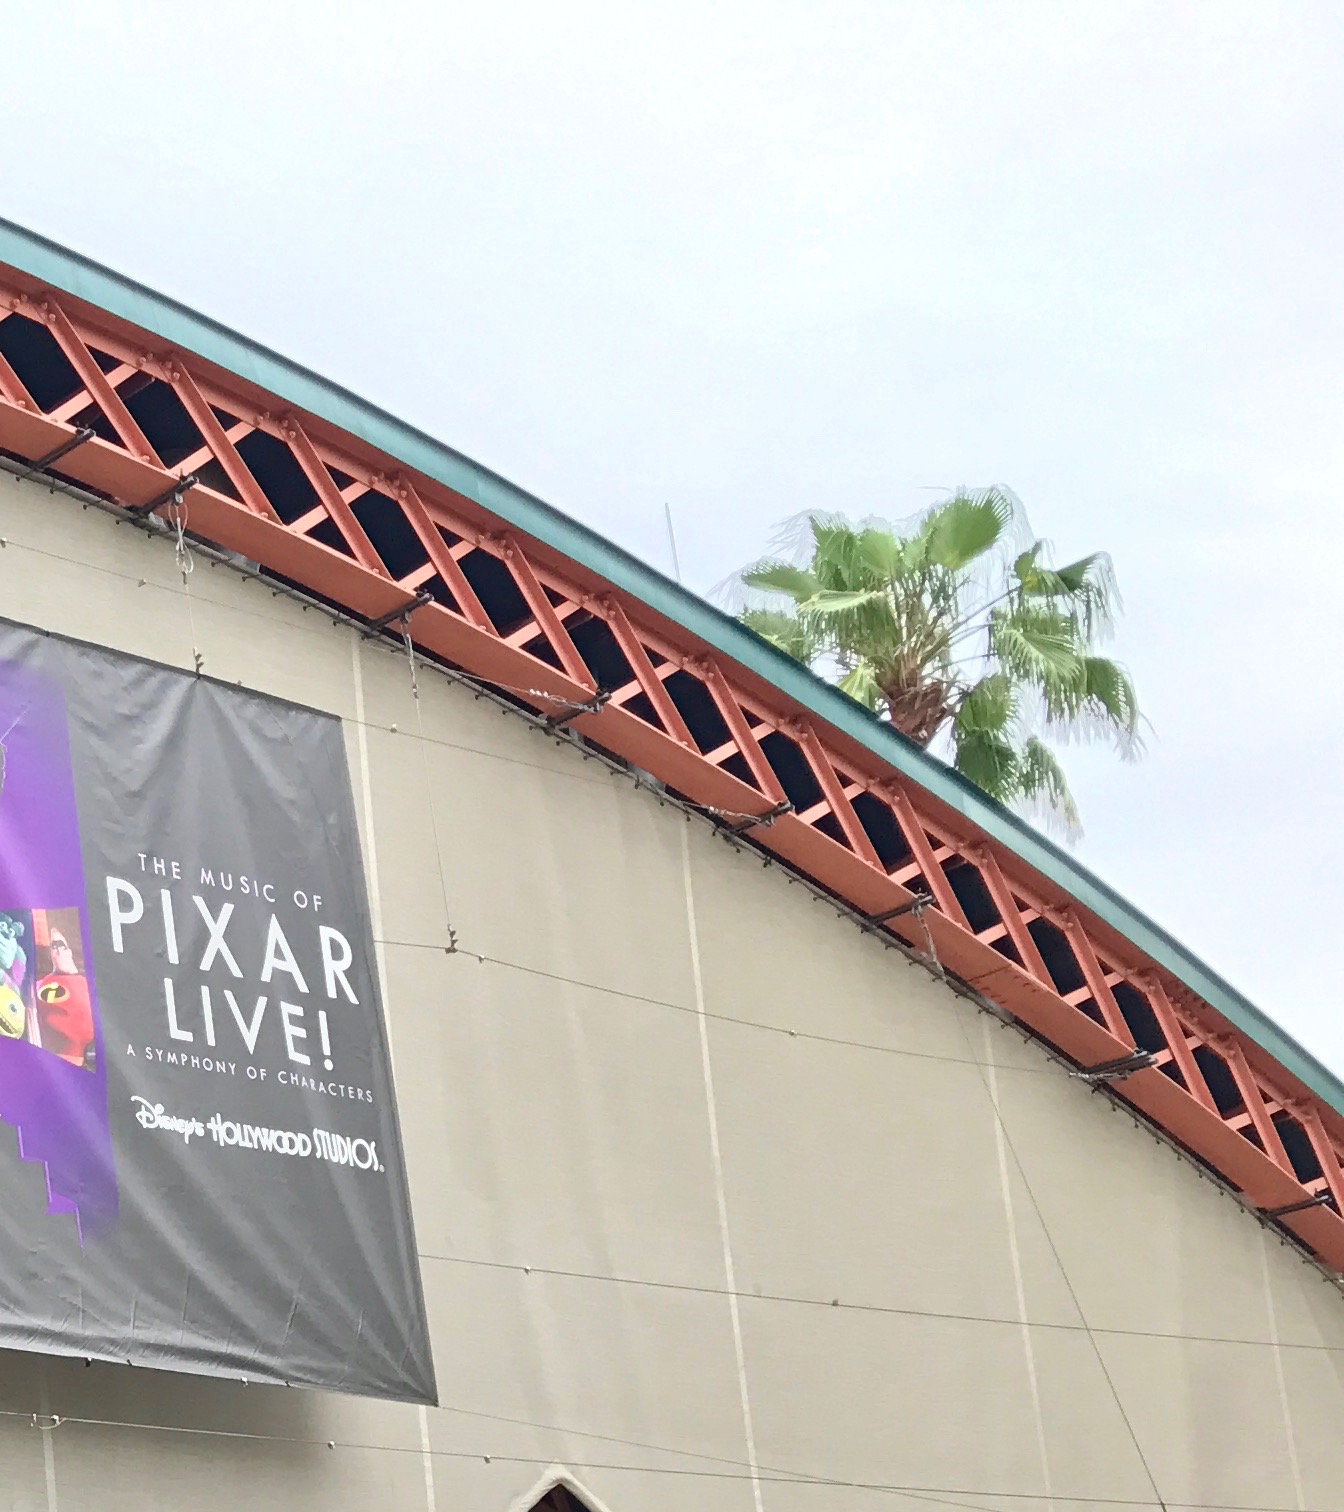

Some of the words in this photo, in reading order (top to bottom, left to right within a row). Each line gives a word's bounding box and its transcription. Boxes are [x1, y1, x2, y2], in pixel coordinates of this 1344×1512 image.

[138, 853, 181, 880] THE
[200, 868, 275, 903] MUSIC
[293, 891, 322, 912] OF
[105, 875, 359, 1005] PIXAR
[164, 978, 334, 1071] LIVE!
[126, 1044, 136, 1057] A
[145, 1047, 236, 1075] SYMPHONY
[246, 1066, 267, 1081] OF
[278, 1071, 373, 1103] CHARACTERS
[207, 1113, 312, 1157] HOLLYWOOD
